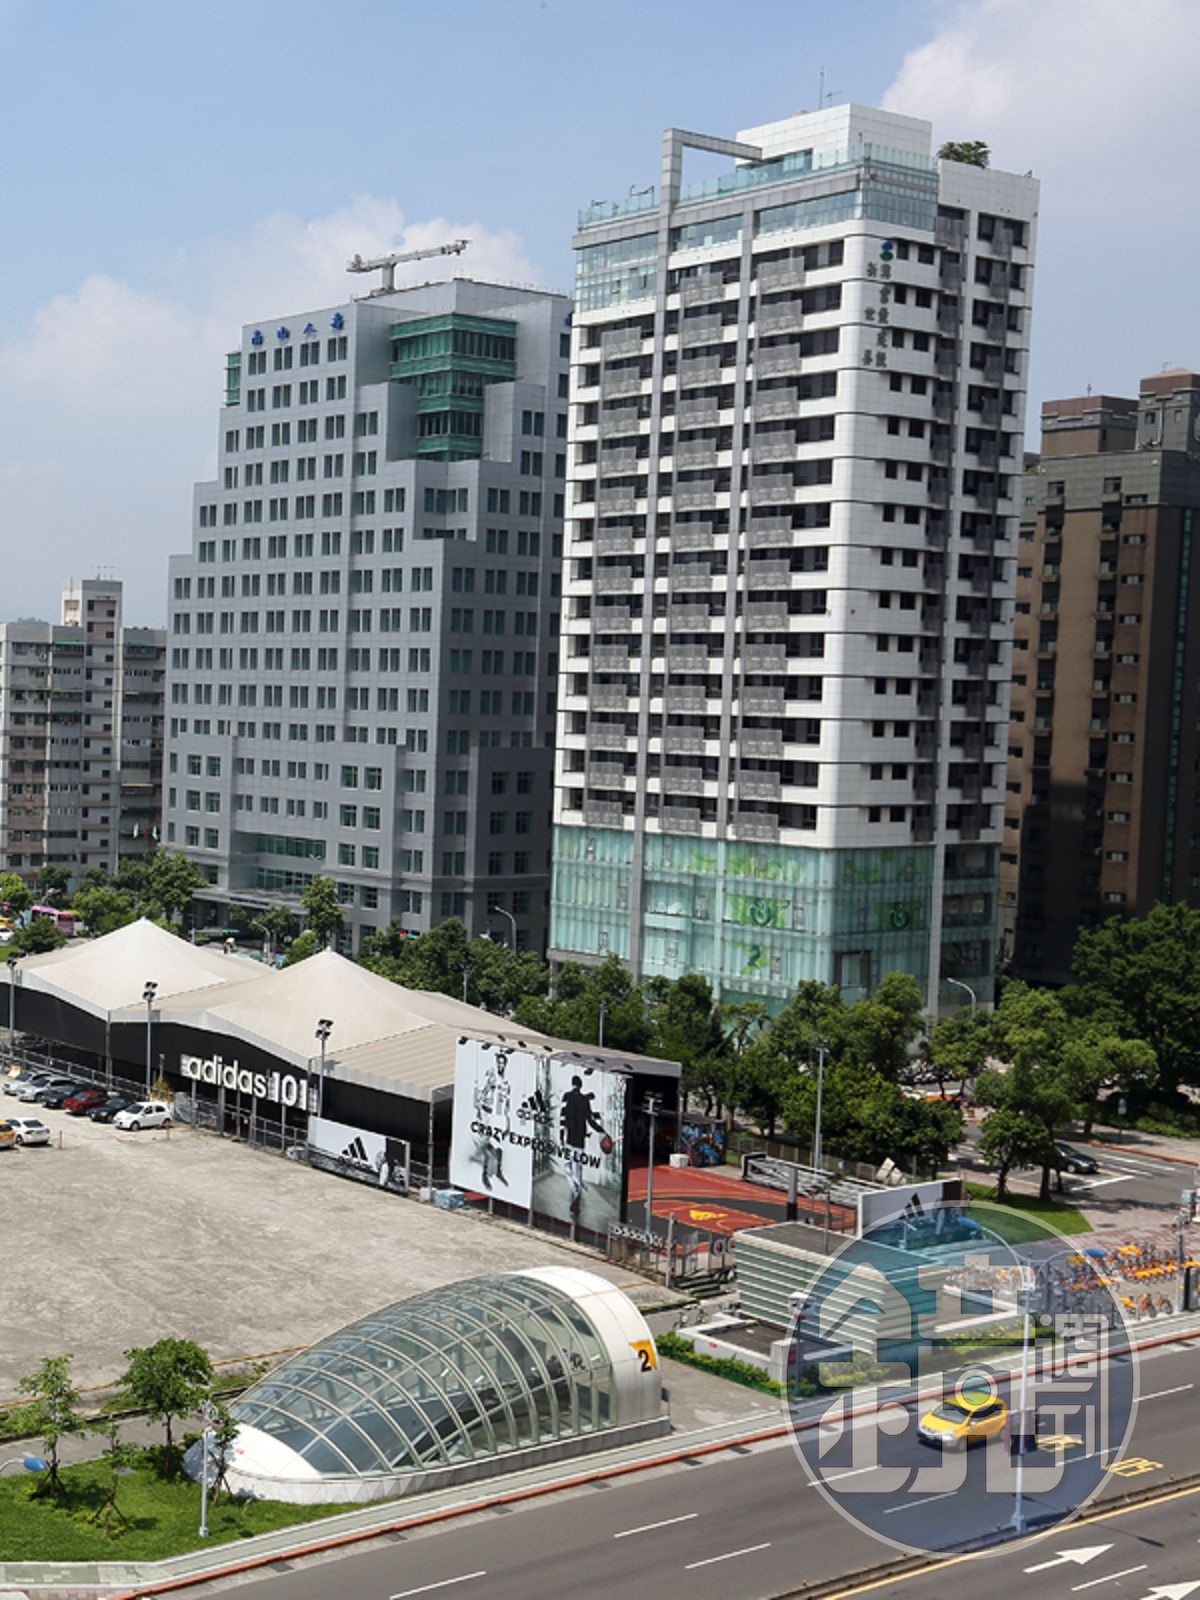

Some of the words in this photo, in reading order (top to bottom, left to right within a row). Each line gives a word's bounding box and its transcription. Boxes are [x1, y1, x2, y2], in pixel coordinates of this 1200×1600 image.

[251, 311, 345, 346] 南山人壽
[470, 1121, 509, 1142] CRAZY
[573, 1151, 601, 1169] LOW
[637, 1348, 653, 1373] 2
